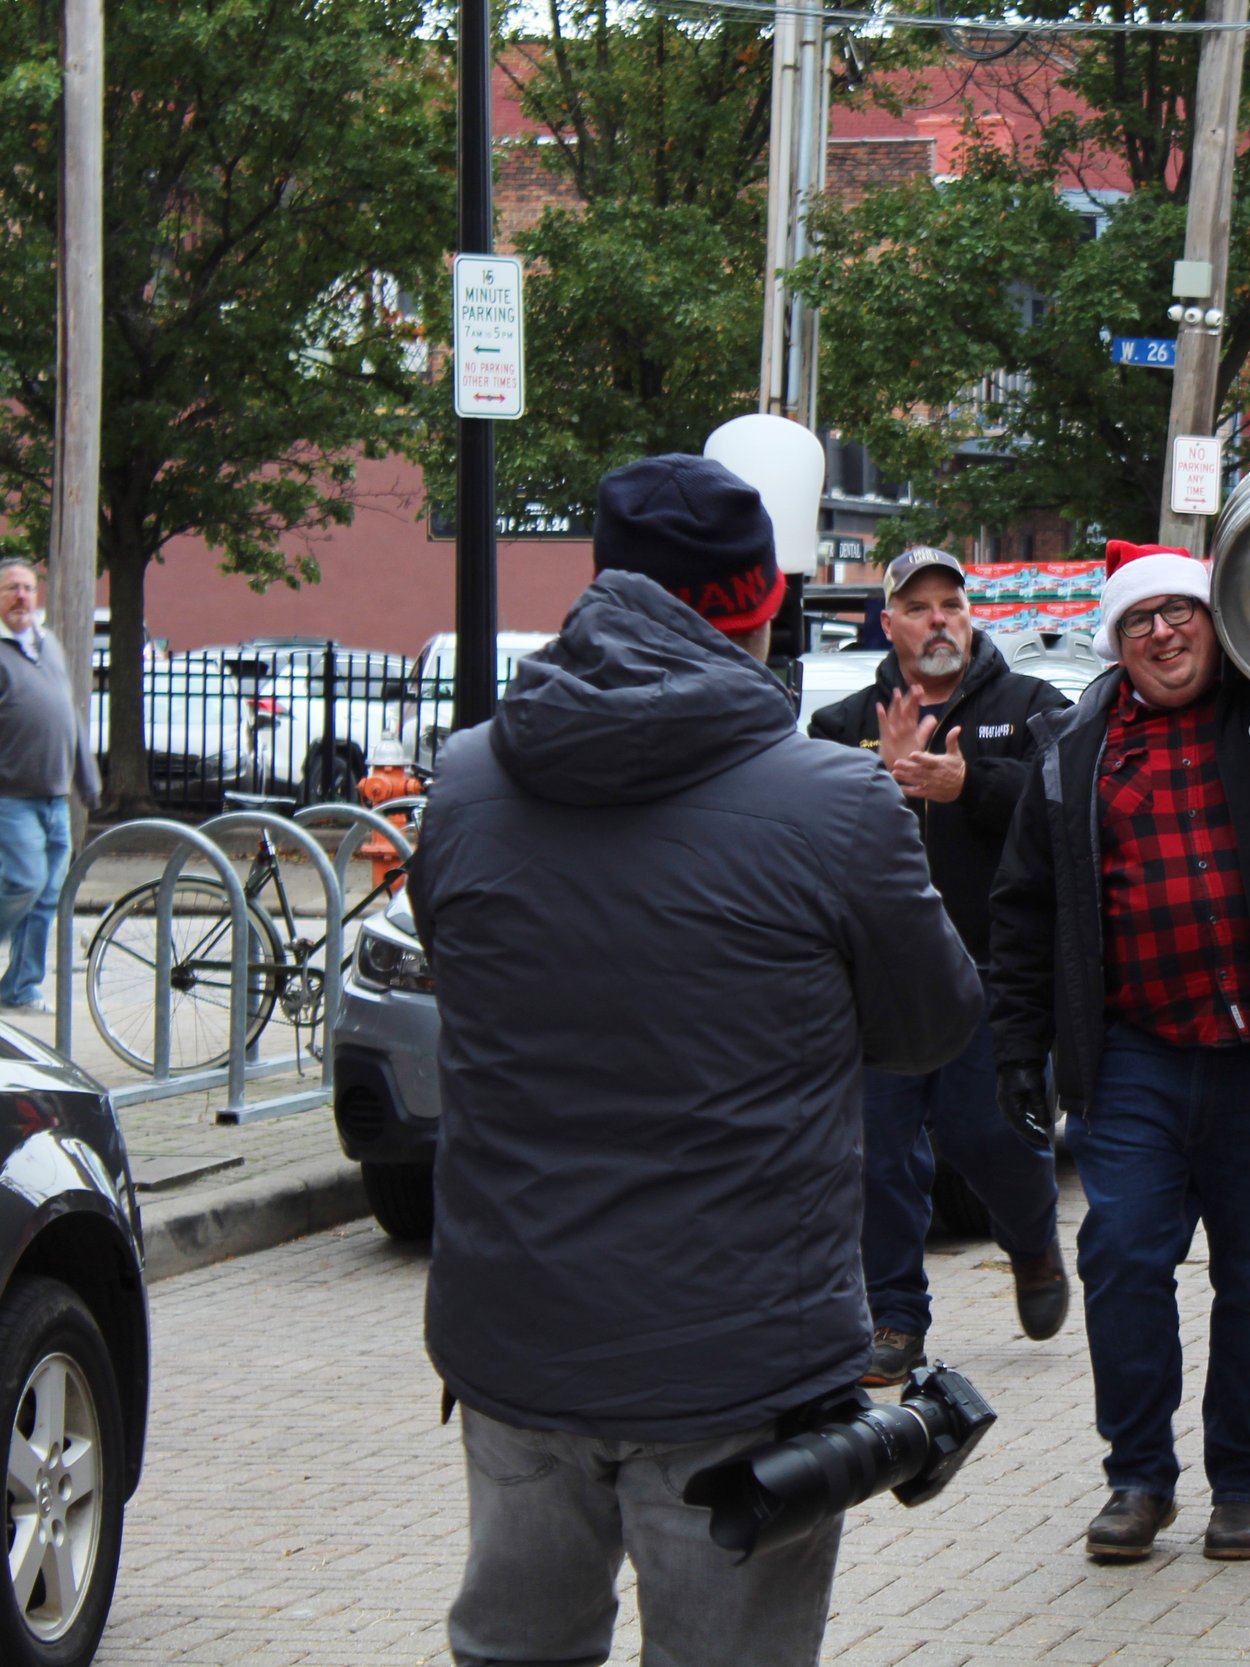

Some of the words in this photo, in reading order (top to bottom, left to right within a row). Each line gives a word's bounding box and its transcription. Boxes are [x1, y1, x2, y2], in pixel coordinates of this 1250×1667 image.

[465, 287, 511, 305] MINUTE
[462, 305, 515, 323] PARKING
[1121, 341, 1139, 361] W.
[1147, 342, 1172, 362] 26
[464, 362, 476, 374] NO
[480, 362, 515, 375] PARKING
[462, 375, 489, 388] OTHER
[493, 376, 517, 389] TIMES
[1189, 447, 1206, 461] NO
[1178, 461, 1215, 474] PARKING
[1187, 474, 1205, 485] ANY
[1186, 486, 1206, 497] TIME
